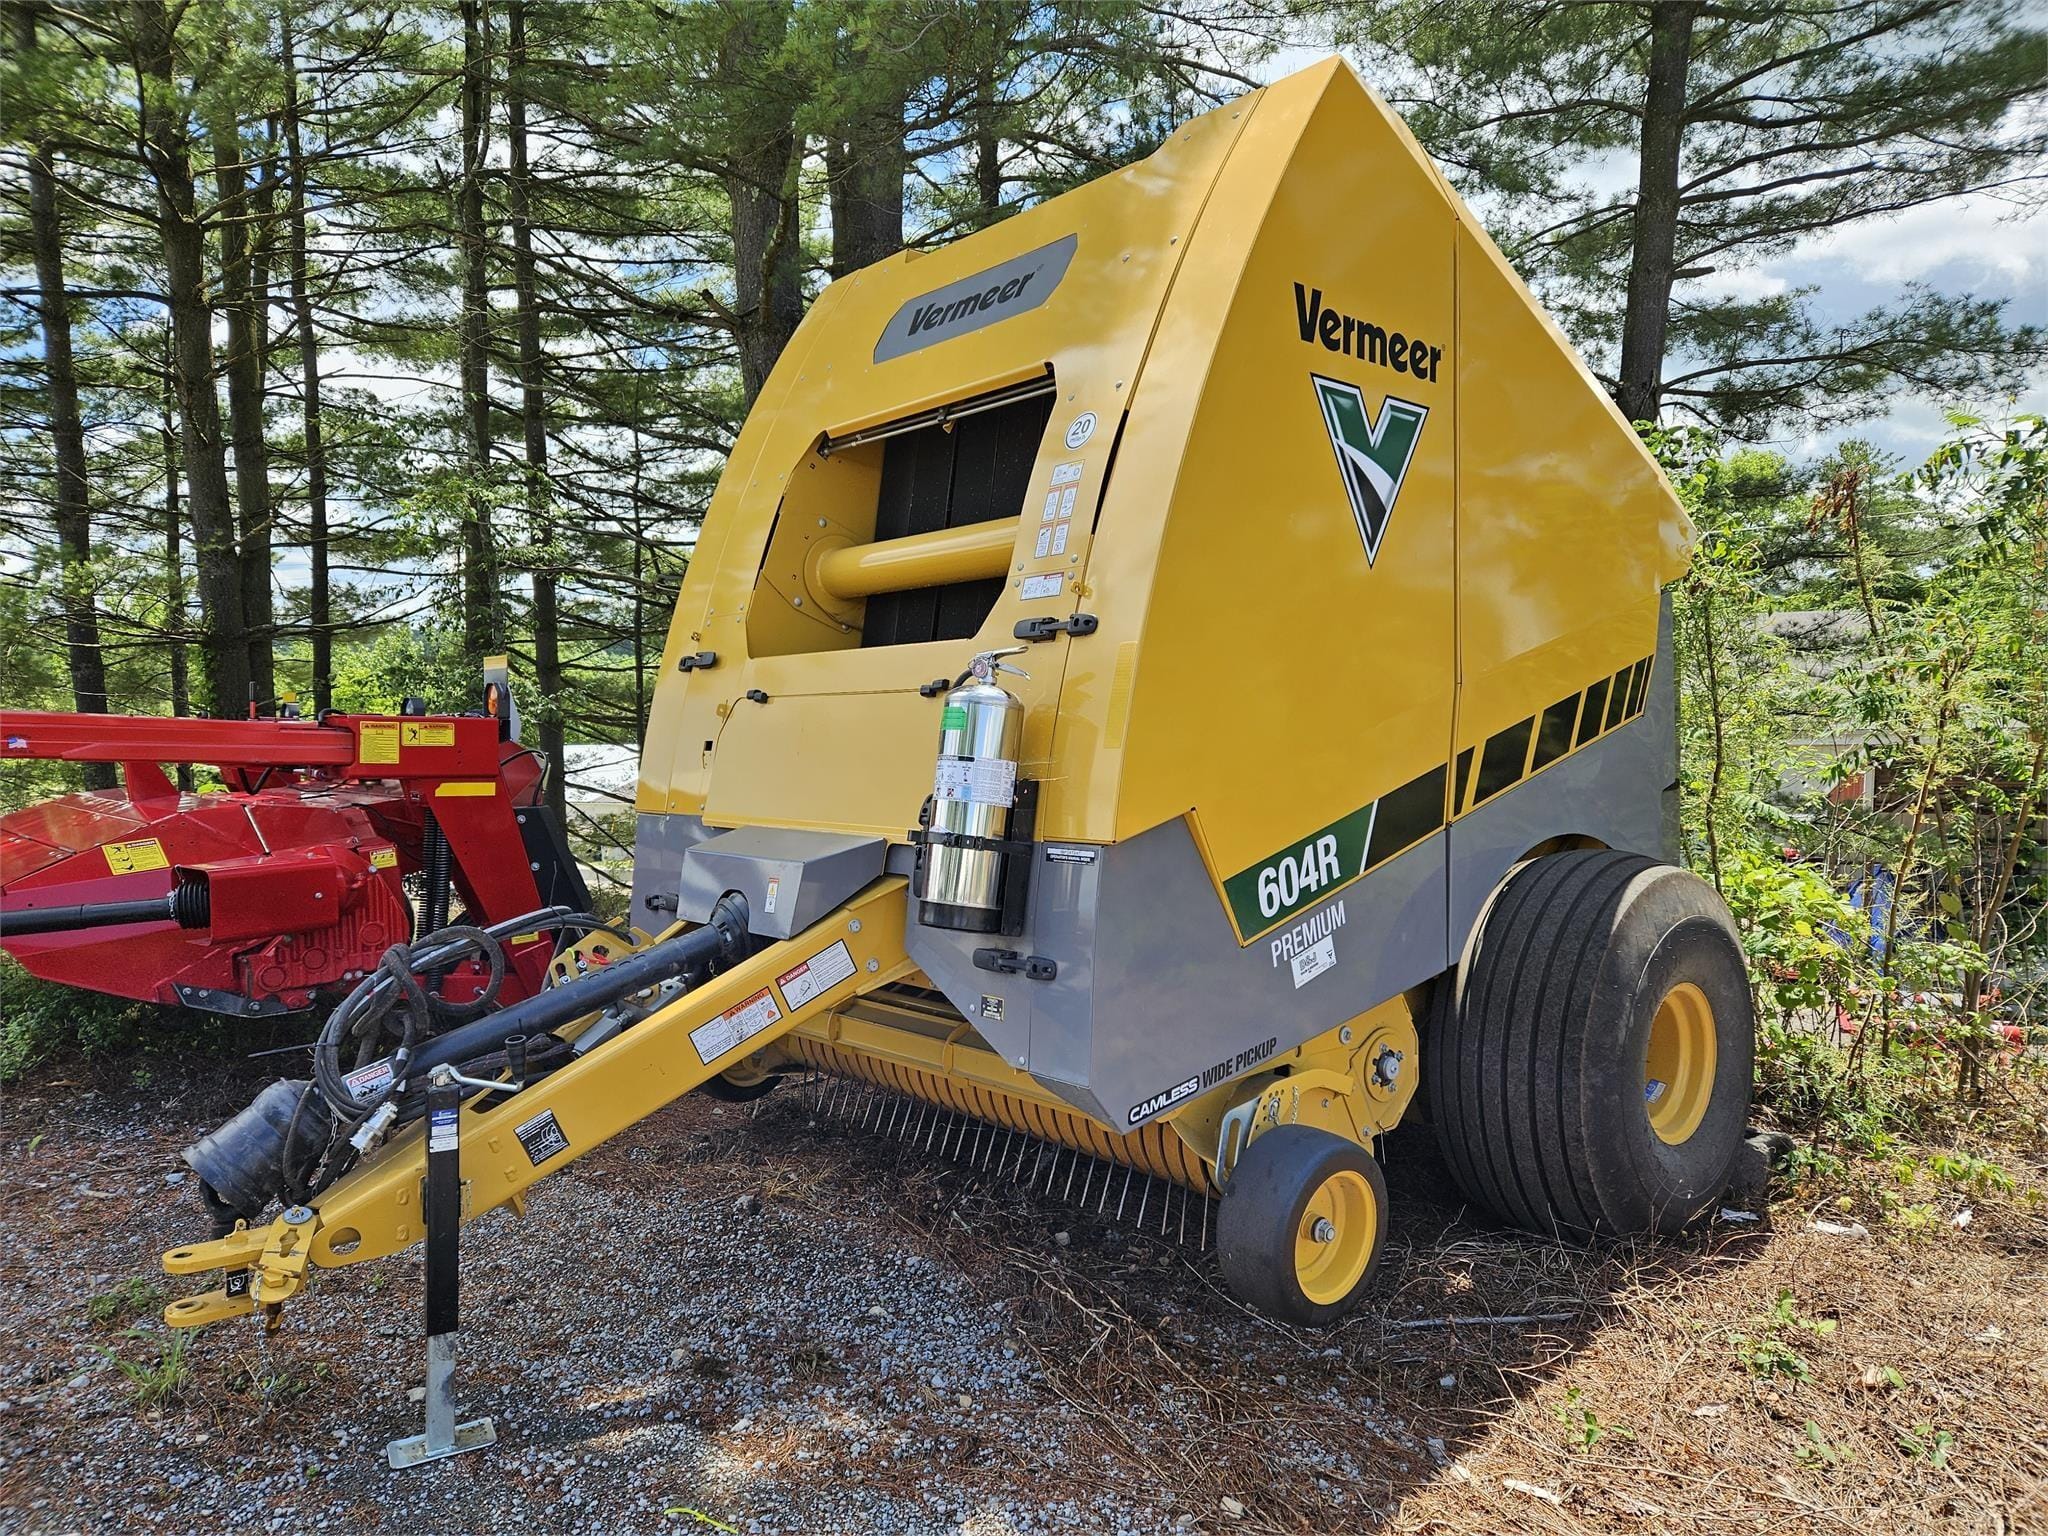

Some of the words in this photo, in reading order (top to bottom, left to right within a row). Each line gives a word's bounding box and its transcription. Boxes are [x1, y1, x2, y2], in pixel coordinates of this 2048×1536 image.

[907, 271, 1036, 337] Vermeer
[1293, 281, 1442, 384] Vermeer
[1071, 418, 1092, 436] 20
[1257, 834, 1341, 918] 604R
[1270, 900, 1346, 968] PREMIUM
[734, 991, 765, 1012] WARNING
[785, 964, 809, 981] DANGER
[359, 1066, 389, 1082] DANGER
[1129, 1077, 1198, 1122] CAMLESS
[1202, 1060, 1233, 1089] WIDE
[1236, 1037, 1277, 1073] PICKUP
